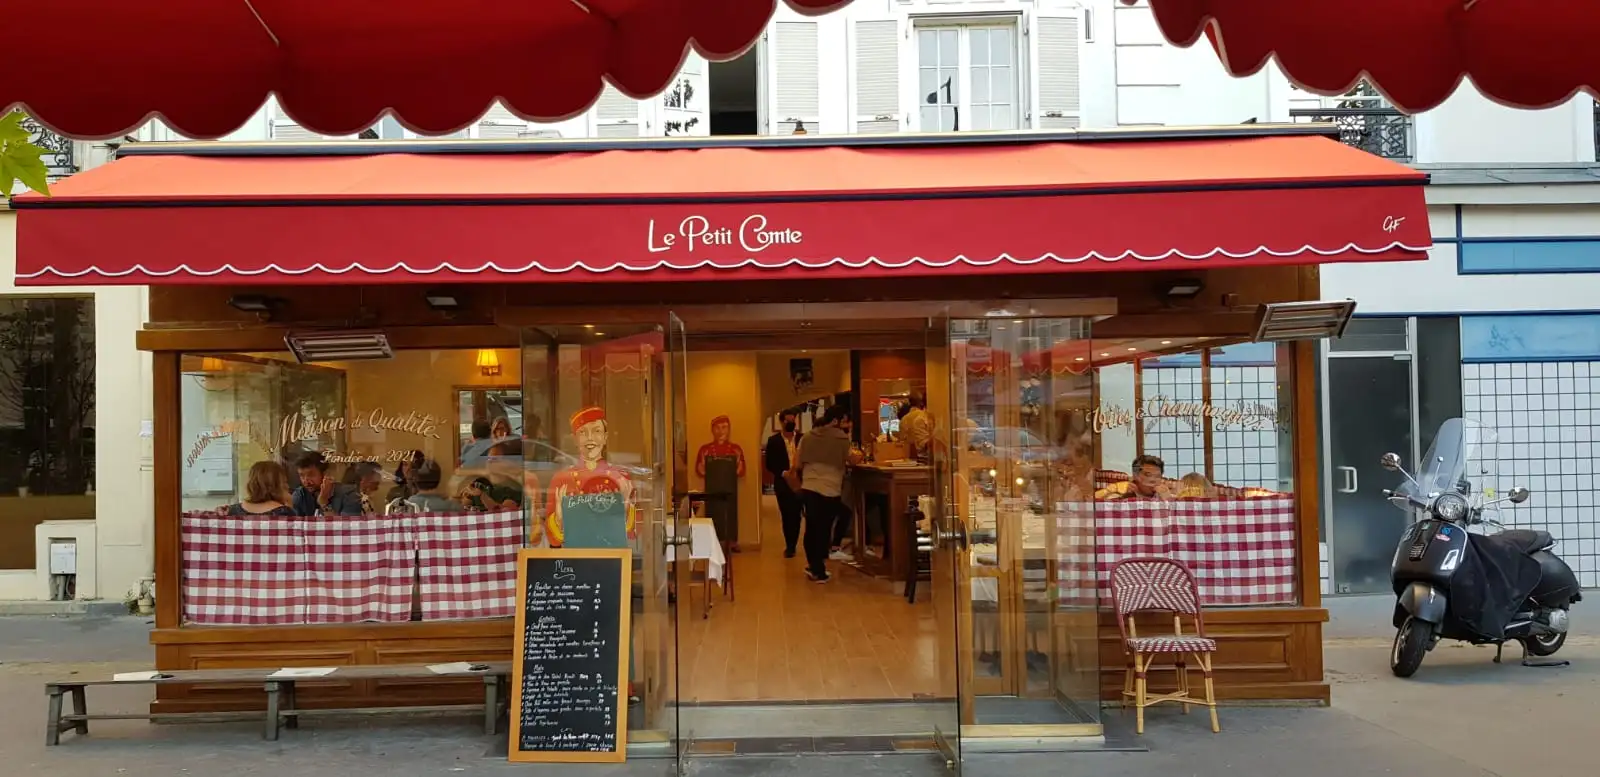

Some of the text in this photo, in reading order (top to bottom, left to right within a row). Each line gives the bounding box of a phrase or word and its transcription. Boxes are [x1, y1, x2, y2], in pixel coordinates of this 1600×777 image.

[648, 214, 803, 252] Le Petit Comte
[270, 411, 346, 452] Maison
[350, 413, 364, 428] de
[368, 406, 448, 439] Qualité
[320, 448, 416, 464] Fondée en 2021
[555, 560, 574, 573] Menu
